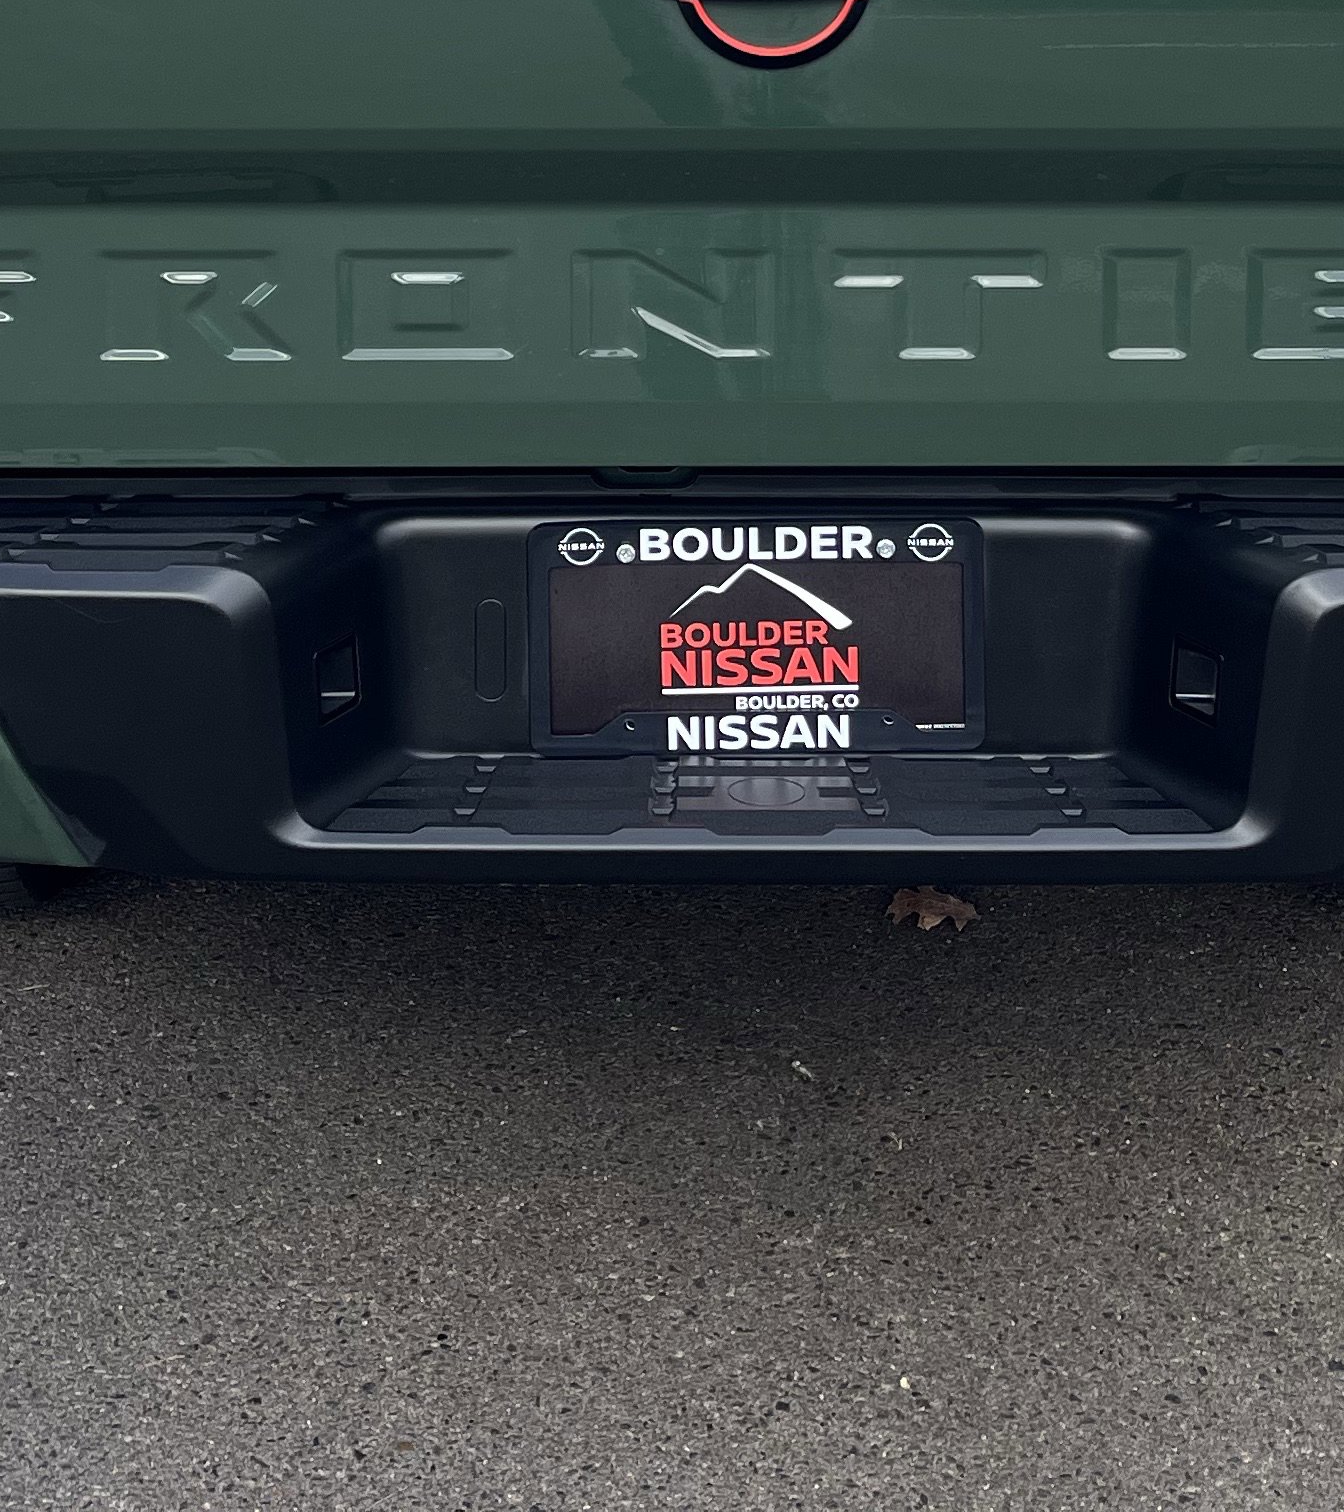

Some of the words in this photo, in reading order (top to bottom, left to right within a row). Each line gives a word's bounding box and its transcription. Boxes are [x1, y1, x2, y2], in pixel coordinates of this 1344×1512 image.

[557, 542, 605, 551] NISSAN
[638, 525, 873, 562] BOULDER
[907, 536, 954, 547] NISSAN
[660, 619, 829, 649] BOULDER
[661, 646, 859, 687] NISSAN
[735, 695, 829, 711] BOULDER,
[832, 694, 859, 709] CO
[667, 714, 850, 751] NISSAN
